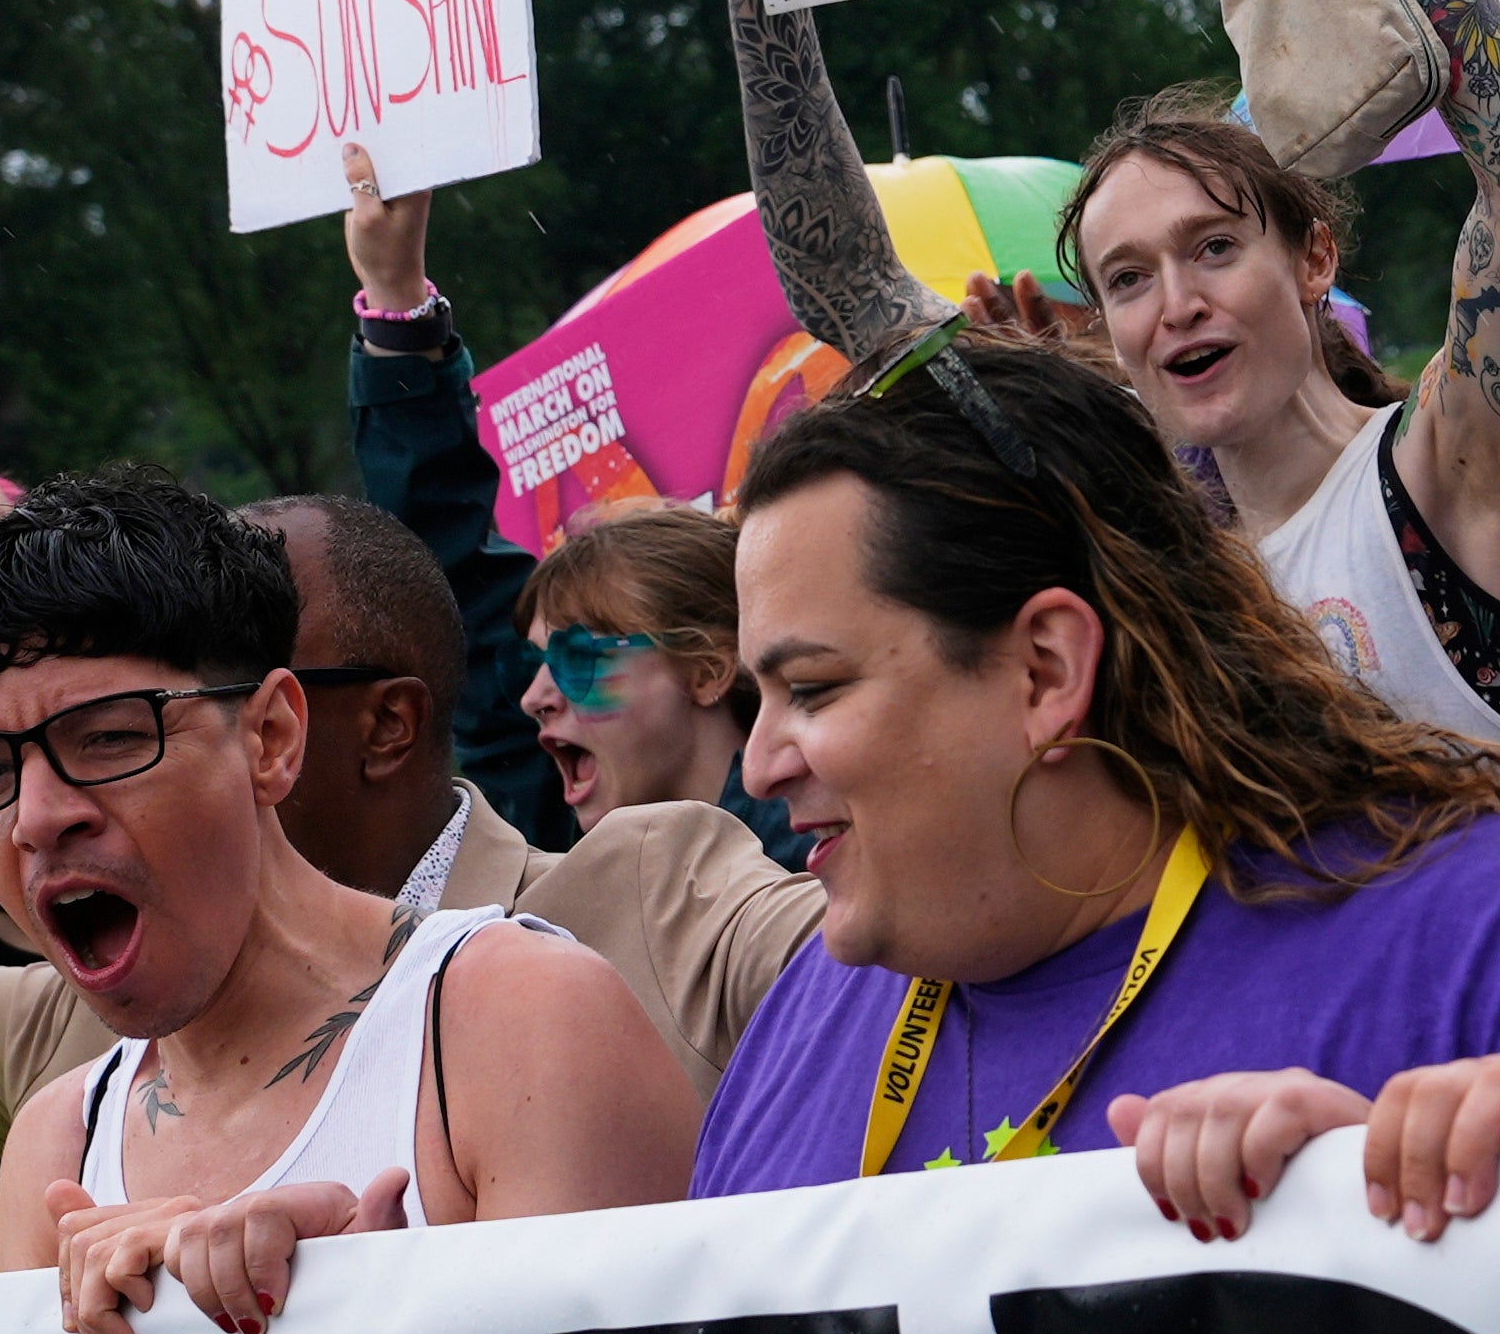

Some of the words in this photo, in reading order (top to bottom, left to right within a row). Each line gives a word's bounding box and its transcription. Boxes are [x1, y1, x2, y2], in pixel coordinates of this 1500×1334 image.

[489, 341, 607, 425] INTERNATIONAL
[497, 385, 574, 451] MARCH
[575, 361, 613, 402] ON
[503, 405, 590, 466] WASHINGTON
[589, 389, 618, 417] FOR
[508, 407, 626, 498] FREEDOM
